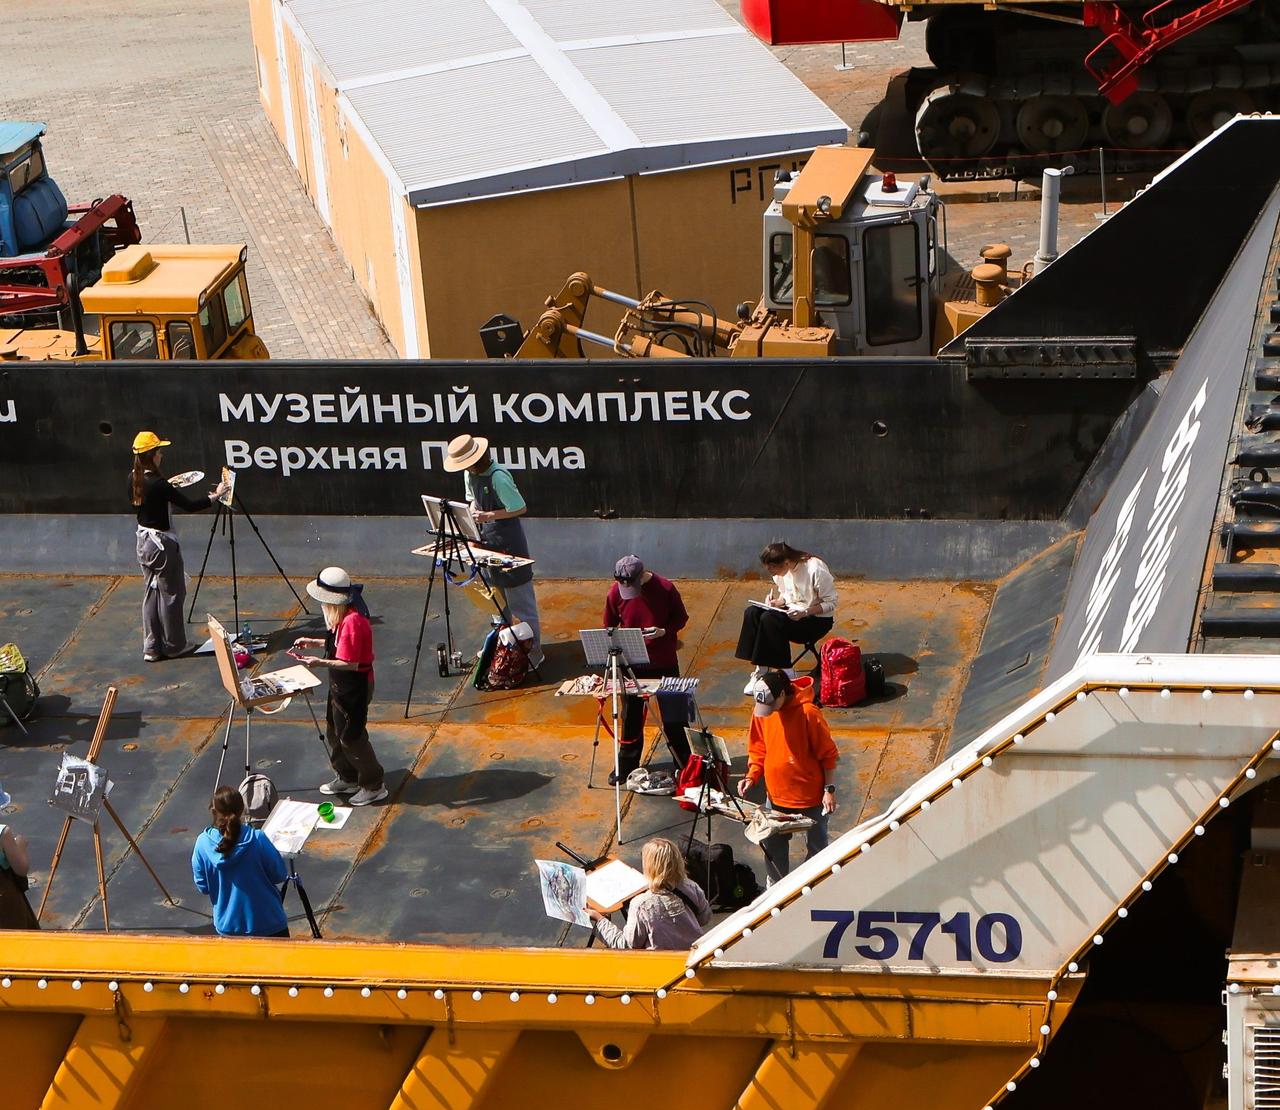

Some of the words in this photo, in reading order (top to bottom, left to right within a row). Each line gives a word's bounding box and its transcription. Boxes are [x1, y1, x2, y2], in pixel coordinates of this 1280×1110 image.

[218, 386, 478, 424] МУЗЕЙНЫЙ
[492, 389, 752, 424] КОМПЛЕКС
[224, 439, 408, 477] Верхняя
[421, 440, 586, 471] Пшма
[810, 909, 1023, 963] 75710
